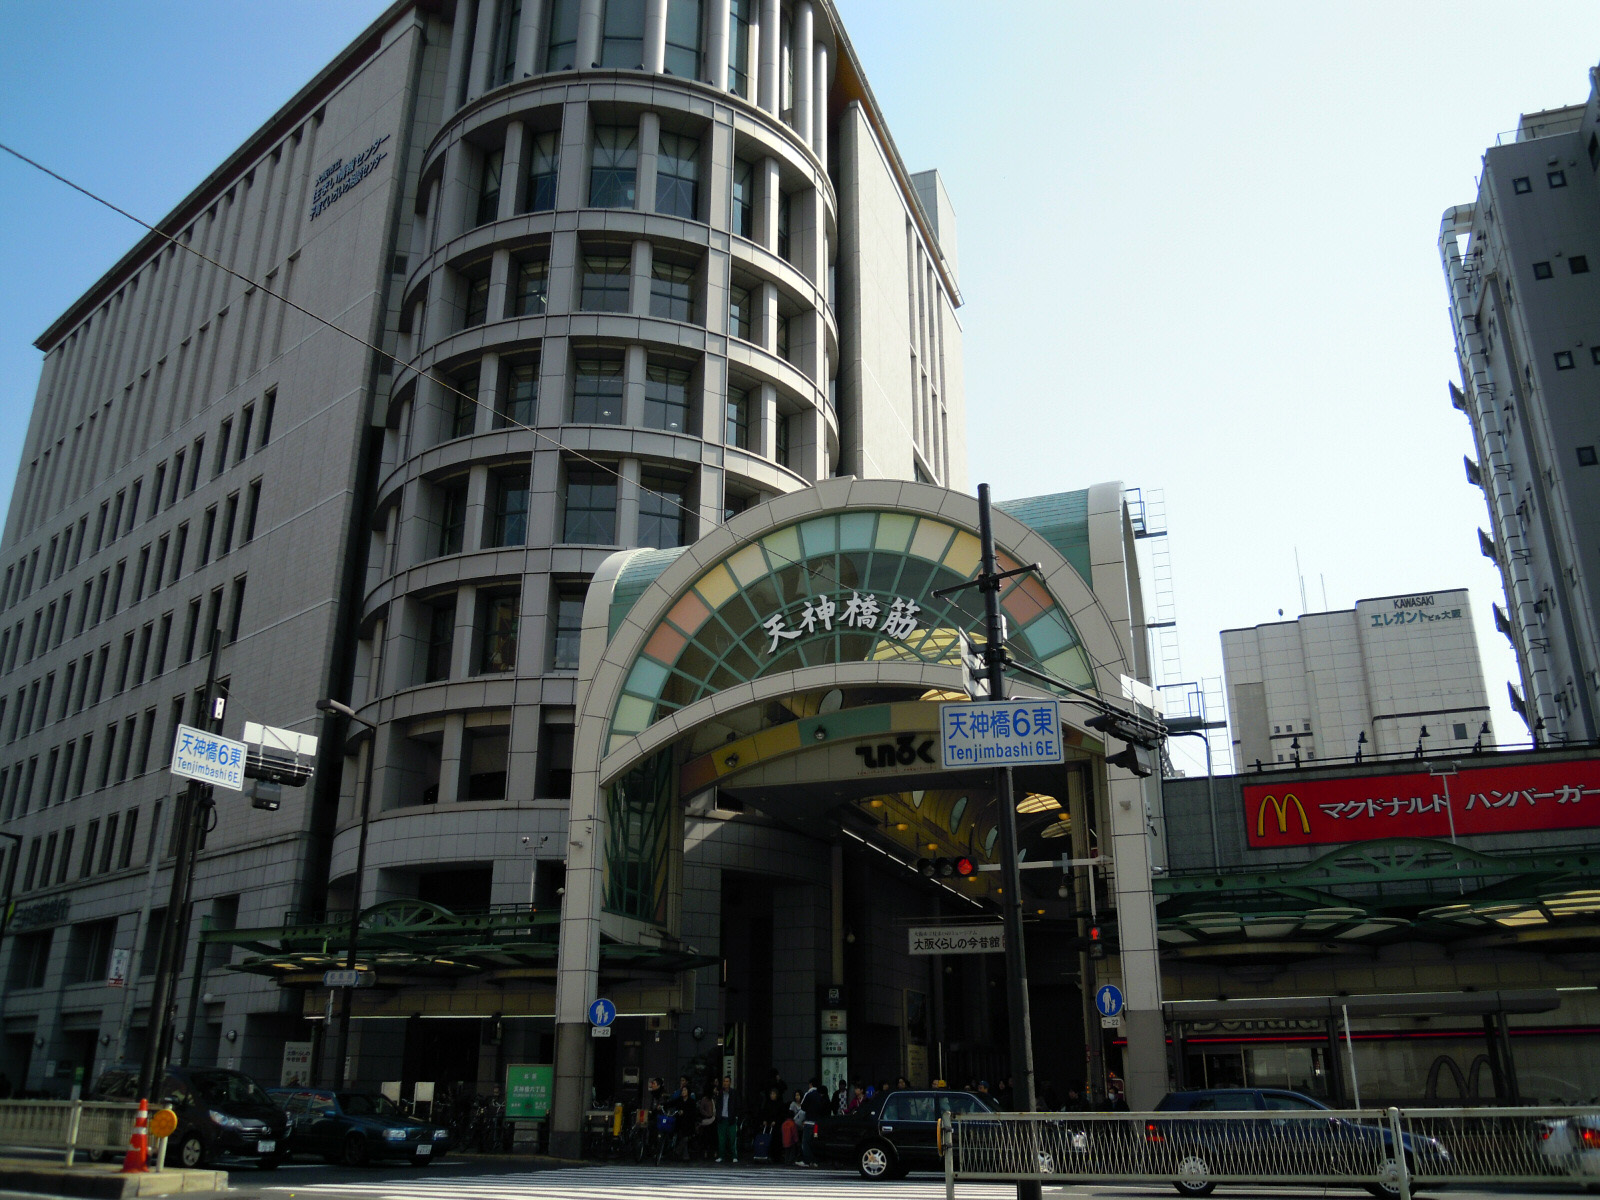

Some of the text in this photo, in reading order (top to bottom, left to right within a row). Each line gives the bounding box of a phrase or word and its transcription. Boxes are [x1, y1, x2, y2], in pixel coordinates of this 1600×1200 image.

[1393, 595, 1435, 609] KAWASAKI
[763, 591, 921, 655] 天神橋筋
[948, 707, 1054, 739] 天神橋6東
[179, 733, 243, 769] 天神橋6東
[949, 742, 1033, 762] Tenjimbashi
[177, 756, 227, 780] Tenjimbashi
[1318, 793, 1449, 819] マクドナルド
[914, 936, 1000, 950] 大阪くらしの今昔館
